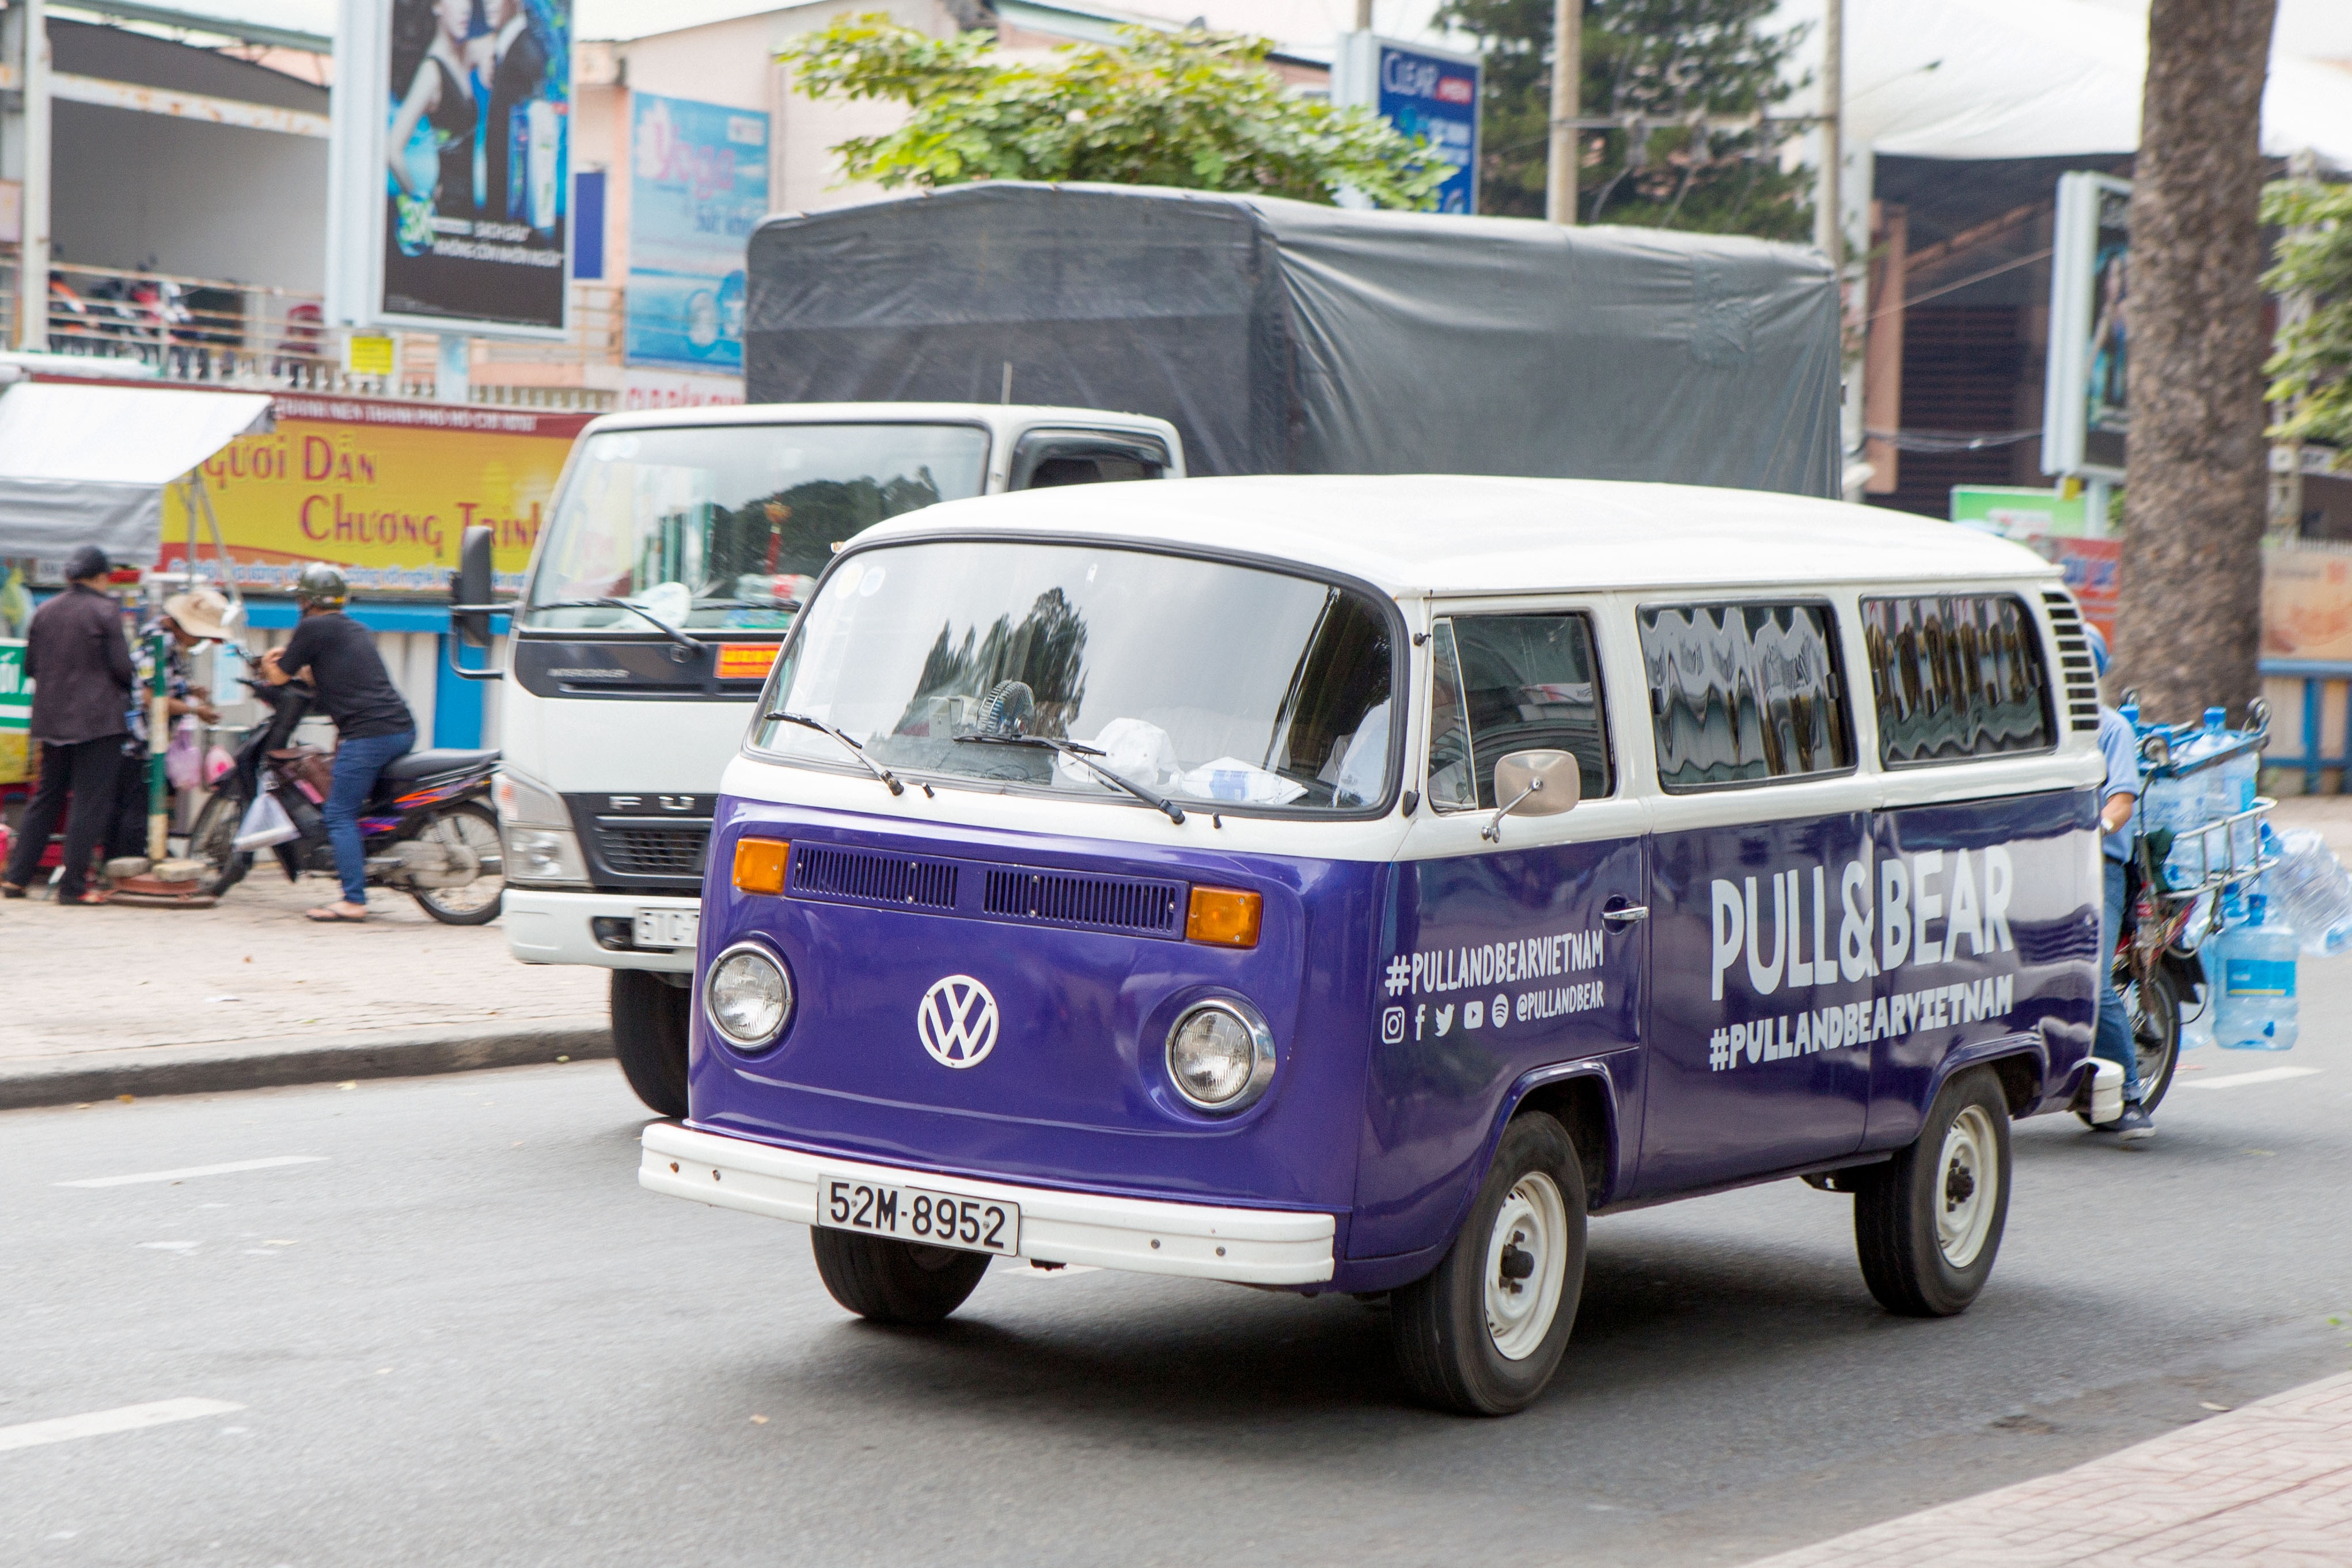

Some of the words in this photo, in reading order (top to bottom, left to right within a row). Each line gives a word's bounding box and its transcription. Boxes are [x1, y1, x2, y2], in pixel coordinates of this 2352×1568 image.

[609, 796, 695, 810] FU
[1711, 845, 2014, 1001] PULL&BEAR
[1384, 929, 1603, 997] #PULLANDBEARVIETNAM
[1516, 981, 1604, 1022] @PULLANDBEAR
[1710, 974, 2013, 1072] #PULLANDBEARVIETNAM
[830, 1182, 1006, 1249] 52M-8952
